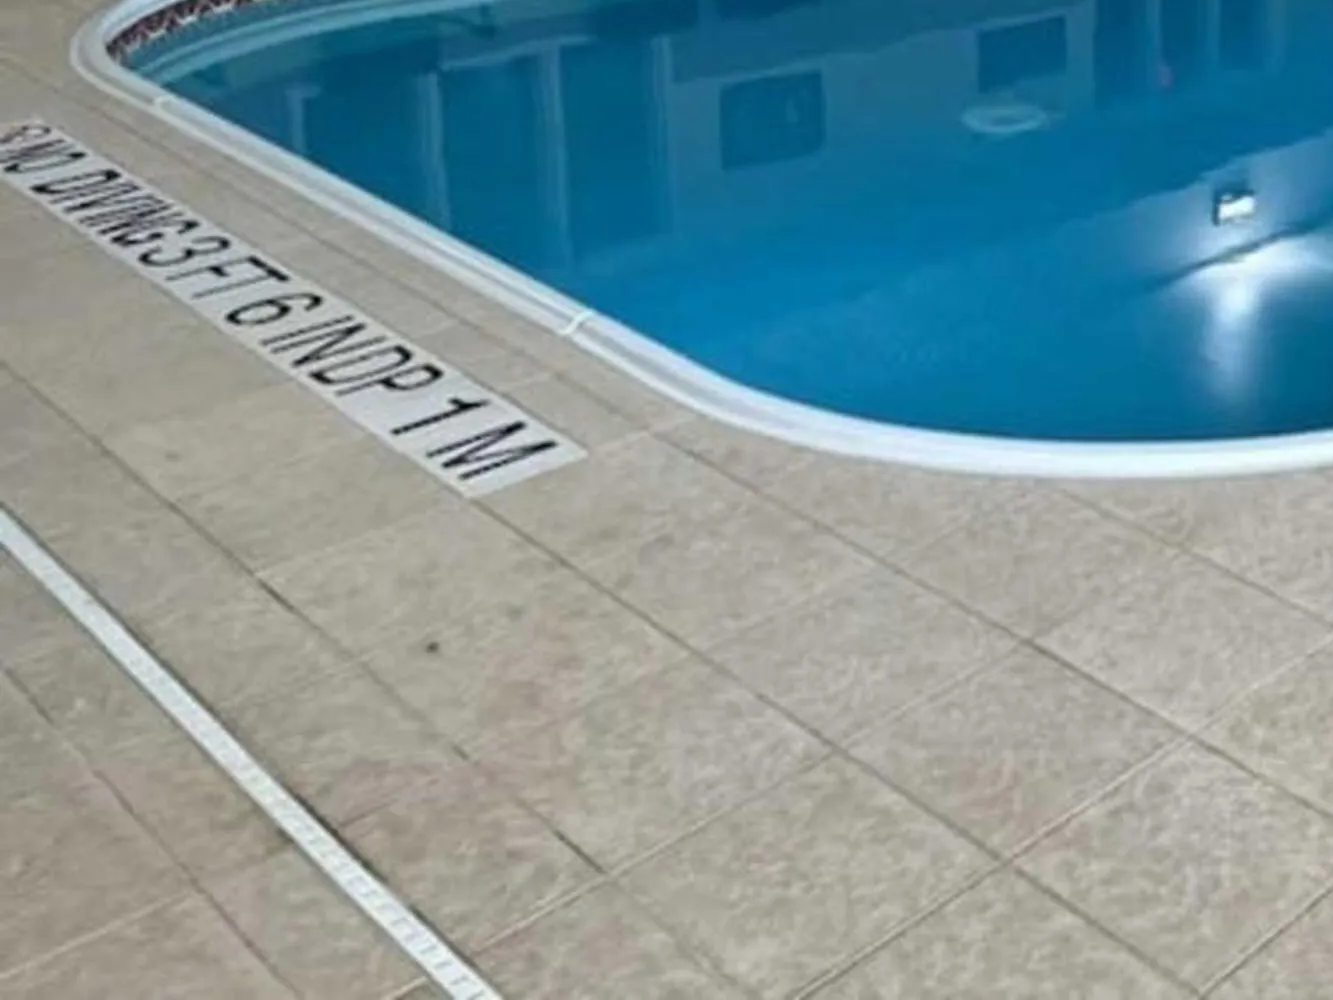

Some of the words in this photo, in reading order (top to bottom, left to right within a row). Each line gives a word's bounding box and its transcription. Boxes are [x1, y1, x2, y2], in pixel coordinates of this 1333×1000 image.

[225, 293, 323, 326] 6
[390, 398, 491, 435] 1
[425, 420, 558, 481] M
